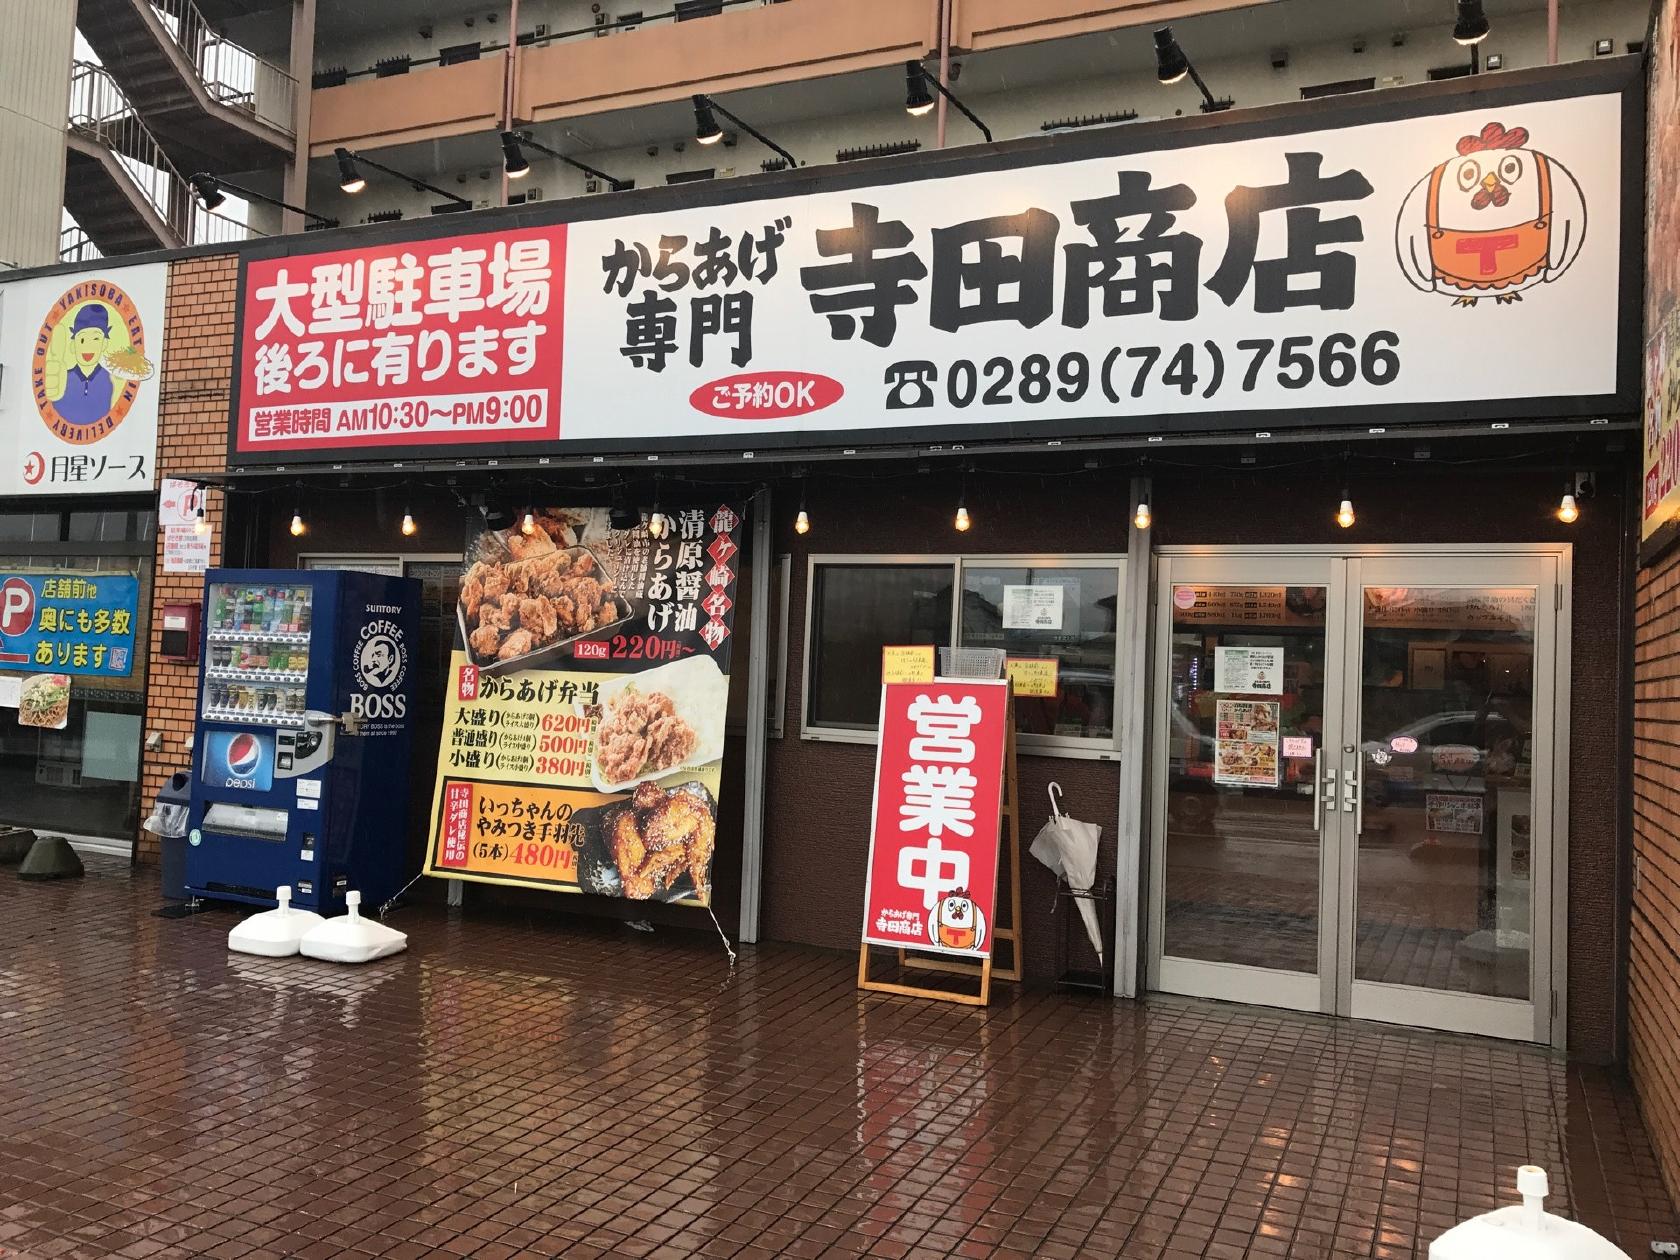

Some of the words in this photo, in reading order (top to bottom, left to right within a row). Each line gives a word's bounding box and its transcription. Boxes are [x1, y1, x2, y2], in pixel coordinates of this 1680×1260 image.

[601, 215, 792, 298] からあげ
[799, 151, 1375, 348] 寺田商店
[59, 283, 124, 311] YAKISOBA
[254, 238, 552, 341] 大型駐車場
[37, 323, 53, 356] OUT
[620, 290, 753, 373] 専門
[254, 319, 547, 396] 後ろに有ります
[946, 330, 1400, 410] 0289(74)7566
[35, 368, 47, 410] TAKE
[712, 380, 816, 410] ご予約OK
[52, 416, 114, 440] DELIVERY
[254, 408, 331, 437] 営業時間
[50, 455, 146, 482] 月星ソース
[647, 512, 677, 632] からあげ
[675, 509, 704, 632] 清原醤油
[41, 578, 97, 599] 店舗前他
[38, 607, 131, 634] 奥にも多数
[366, 604, 402, 614] SUNTORY
[360, 620, 404, 642] COFFEE
[35, 640, 107, 668] あります
[353, 640, 364, 671] COFFEE
[577, 644, 607, 657] 120g
[461, 667, 474, 697] 名物
[479, 675, 600, 706] からあげ弁当
[350, 693, 406, 719] BOSS
[454, 707, 500, 726] 大盛り
[542, 713, 591, 733] 620円
[451, 728, 498, 748] 普通盛り
[539, 735, 588, 755] 500円
[449, 749, 495, 769] 小盛り
[535, 756, 585, 776] 380円
[225, 777, 256, 789] pepsi
[479, 795, 573, 822] いっちゃんの
[896, 693, 982, 911] 営業中
[477, 817, 586, 847] やみつき手羽先
[473, 842, 509, 862] (5本)
[509, 843, 572, 869] 480円
[875, 918, 923, 936] 寺田商店
